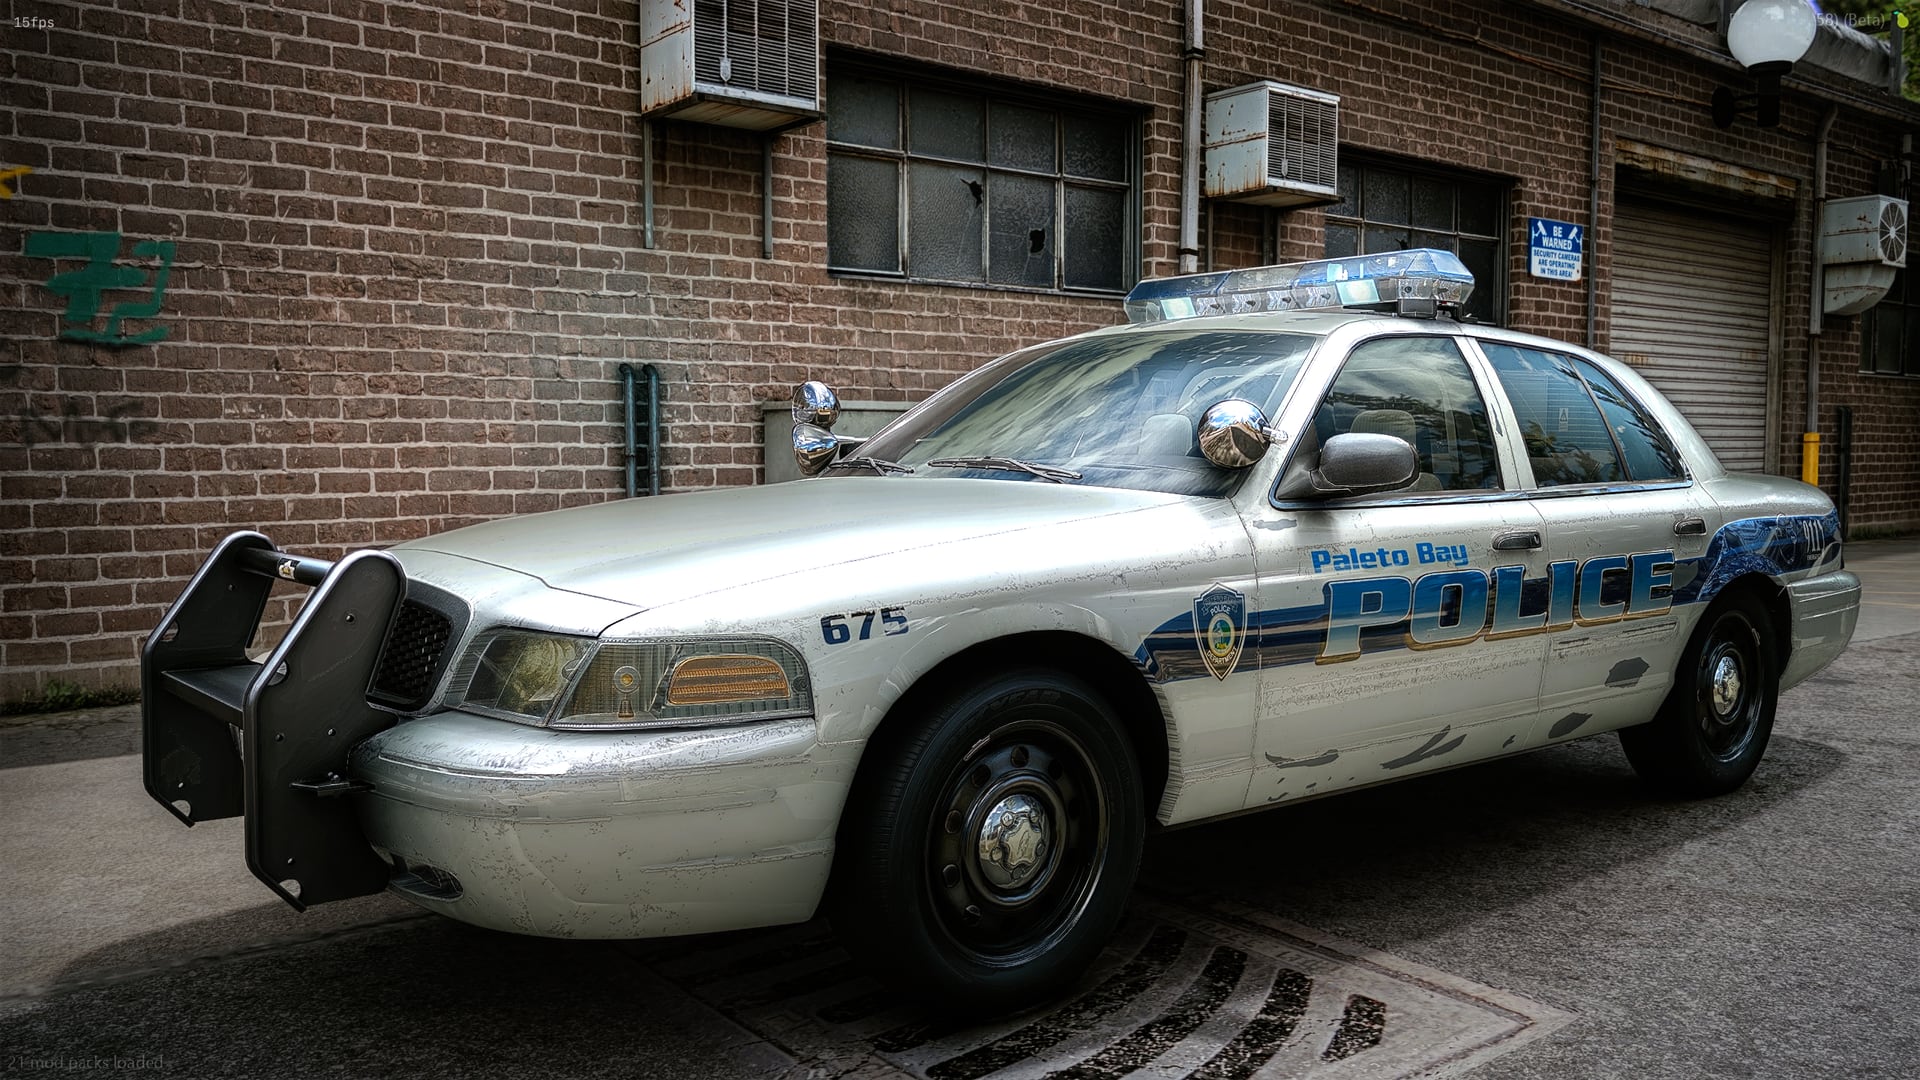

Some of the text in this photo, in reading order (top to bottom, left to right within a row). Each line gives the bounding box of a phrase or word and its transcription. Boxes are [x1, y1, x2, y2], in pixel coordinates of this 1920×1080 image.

[1553, 226, 1563, 237] BE
[1542, 237, 1572, 250] WARNED
[1534, 250, 1580, 262] SECURITY CAMERAS
[1549, 260, 1575, 269] OPERATING
[1310, 542, 1469, 574] Paleto Bay
[1210, 605, 1231, 616] POLICE
[1315, 550, 1676, 665] POLICE
[820, 605, 910, 645] 675
[1206, 645, 1238, 665] DEPARTMENT
